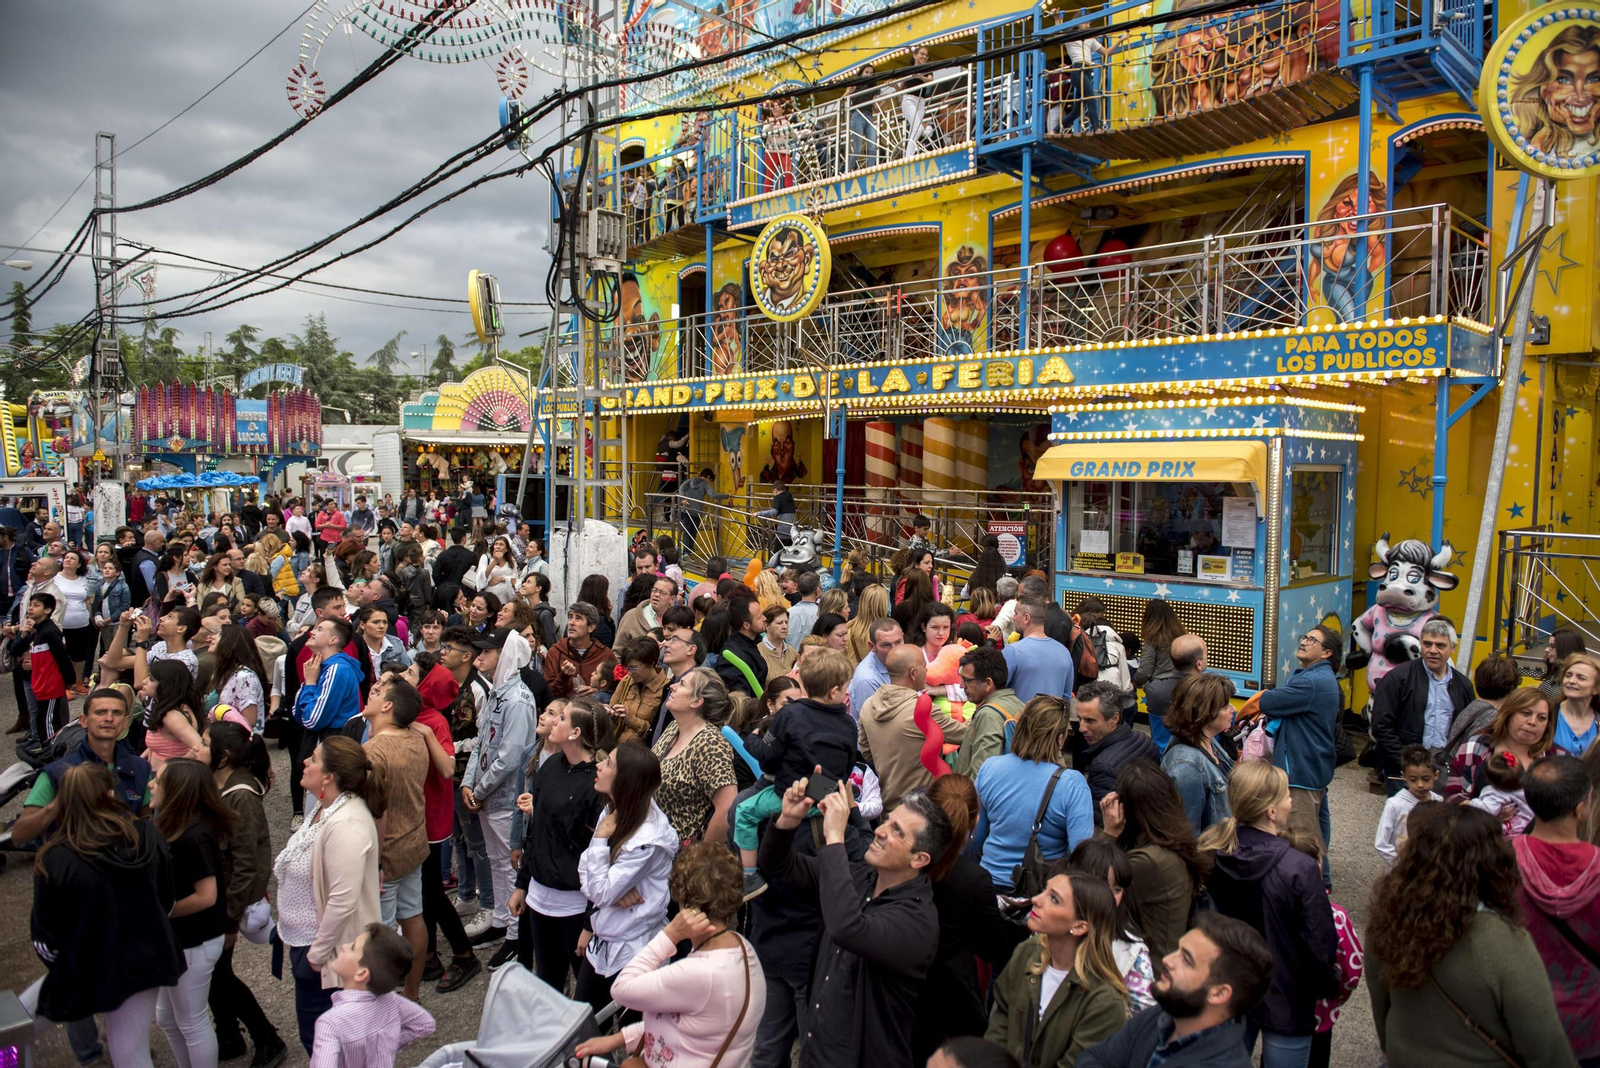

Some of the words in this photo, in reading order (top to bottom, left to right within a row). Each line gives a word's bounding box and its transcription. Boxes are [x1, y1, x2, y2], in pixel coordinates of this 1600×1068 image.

[751, 199, 790, 220] PARA
[841, 178, 864, 199] LA
[867, 158, 941, 193] FAMILIA
[1285, 334, 1340, 354] PARA
[1346, 328, 1428, 350] TODOS
[1276, 354, 1316, 373] LOS
[1322, 347, 1437, 371] PUBLICOS
[600, 385, 692, 409] GRAND
[705, 377, 778, 404] PRIX
[793, 372, 840, 398] DE
[858, 368, 911, 394] LA
[931, 355, 1075, 391] FERIA
[237, 432, 267, 442] LUCAS
[1070, 461, 1141, 477] GRAND
[1146, 460, 1196, 477] PRIX
[1545, 409, 1560, 576] SALIDA
